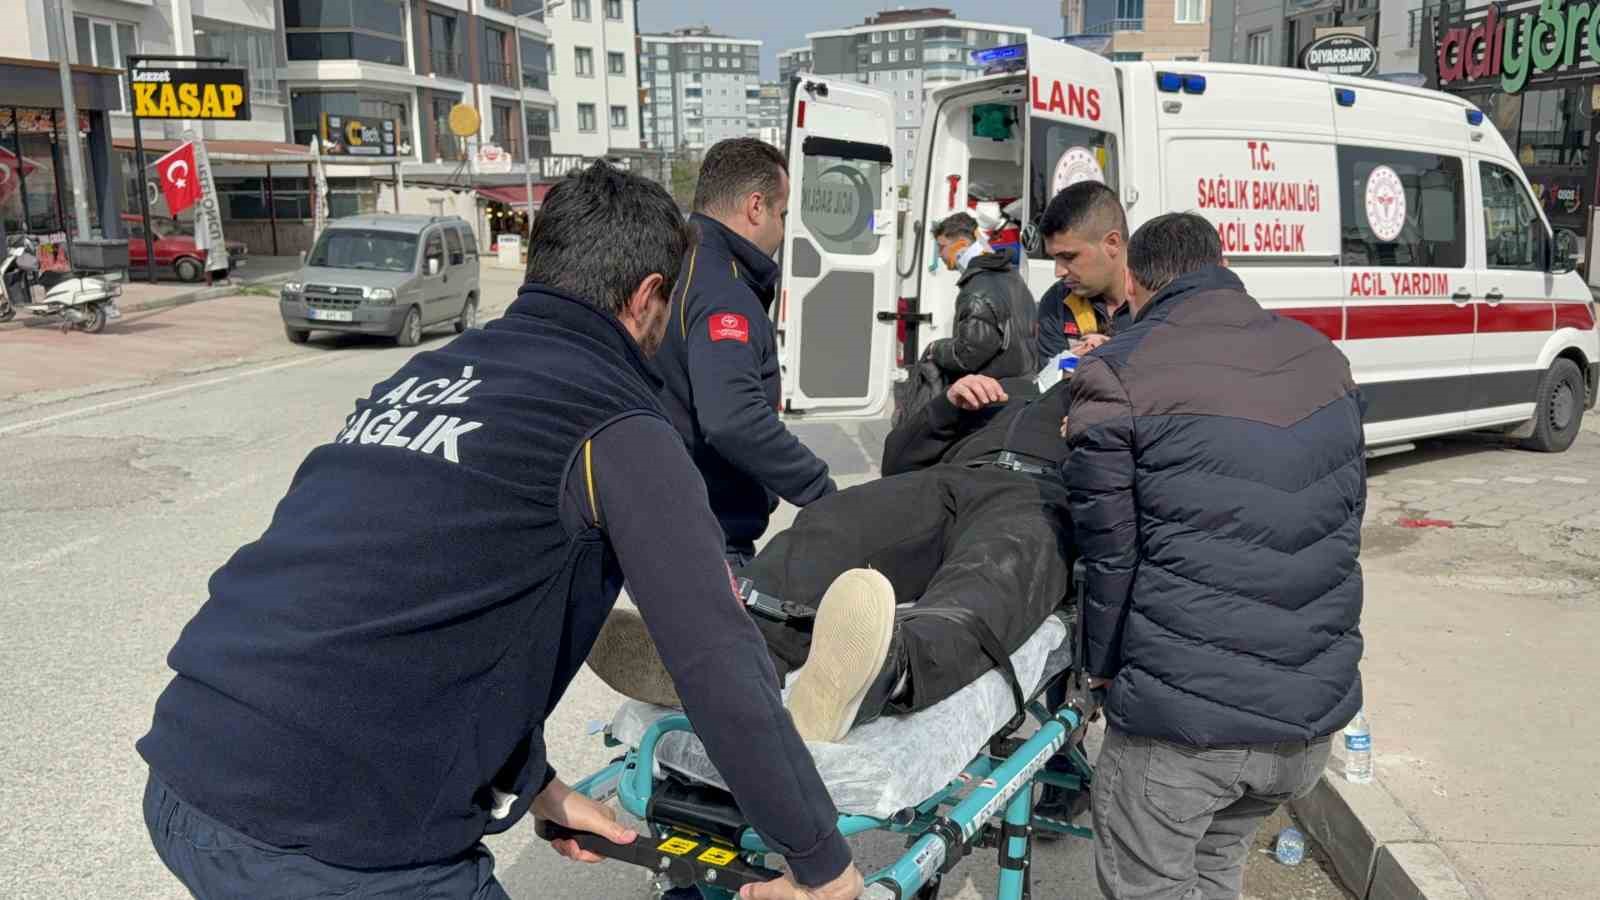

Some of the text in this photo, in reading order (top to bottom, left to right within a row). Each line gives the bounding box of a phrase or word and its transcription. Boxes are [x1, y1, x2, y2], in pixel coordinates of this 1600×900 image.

[132, 69, 170, 81] Lezzet
[133, 83, 243, 118] KASAP
[1032, 76, 1101, 121] LANS
[1248, 141, 1275, 171] T.C.
[1198, 174, 1320, 212] SAĞLIK BAKANLIĞI
[1254, 218, 1304, 252] SAĞLIK
[1392, 273, 1448, 296] YARDIM
[376, 366, 482, 405] ACİL
